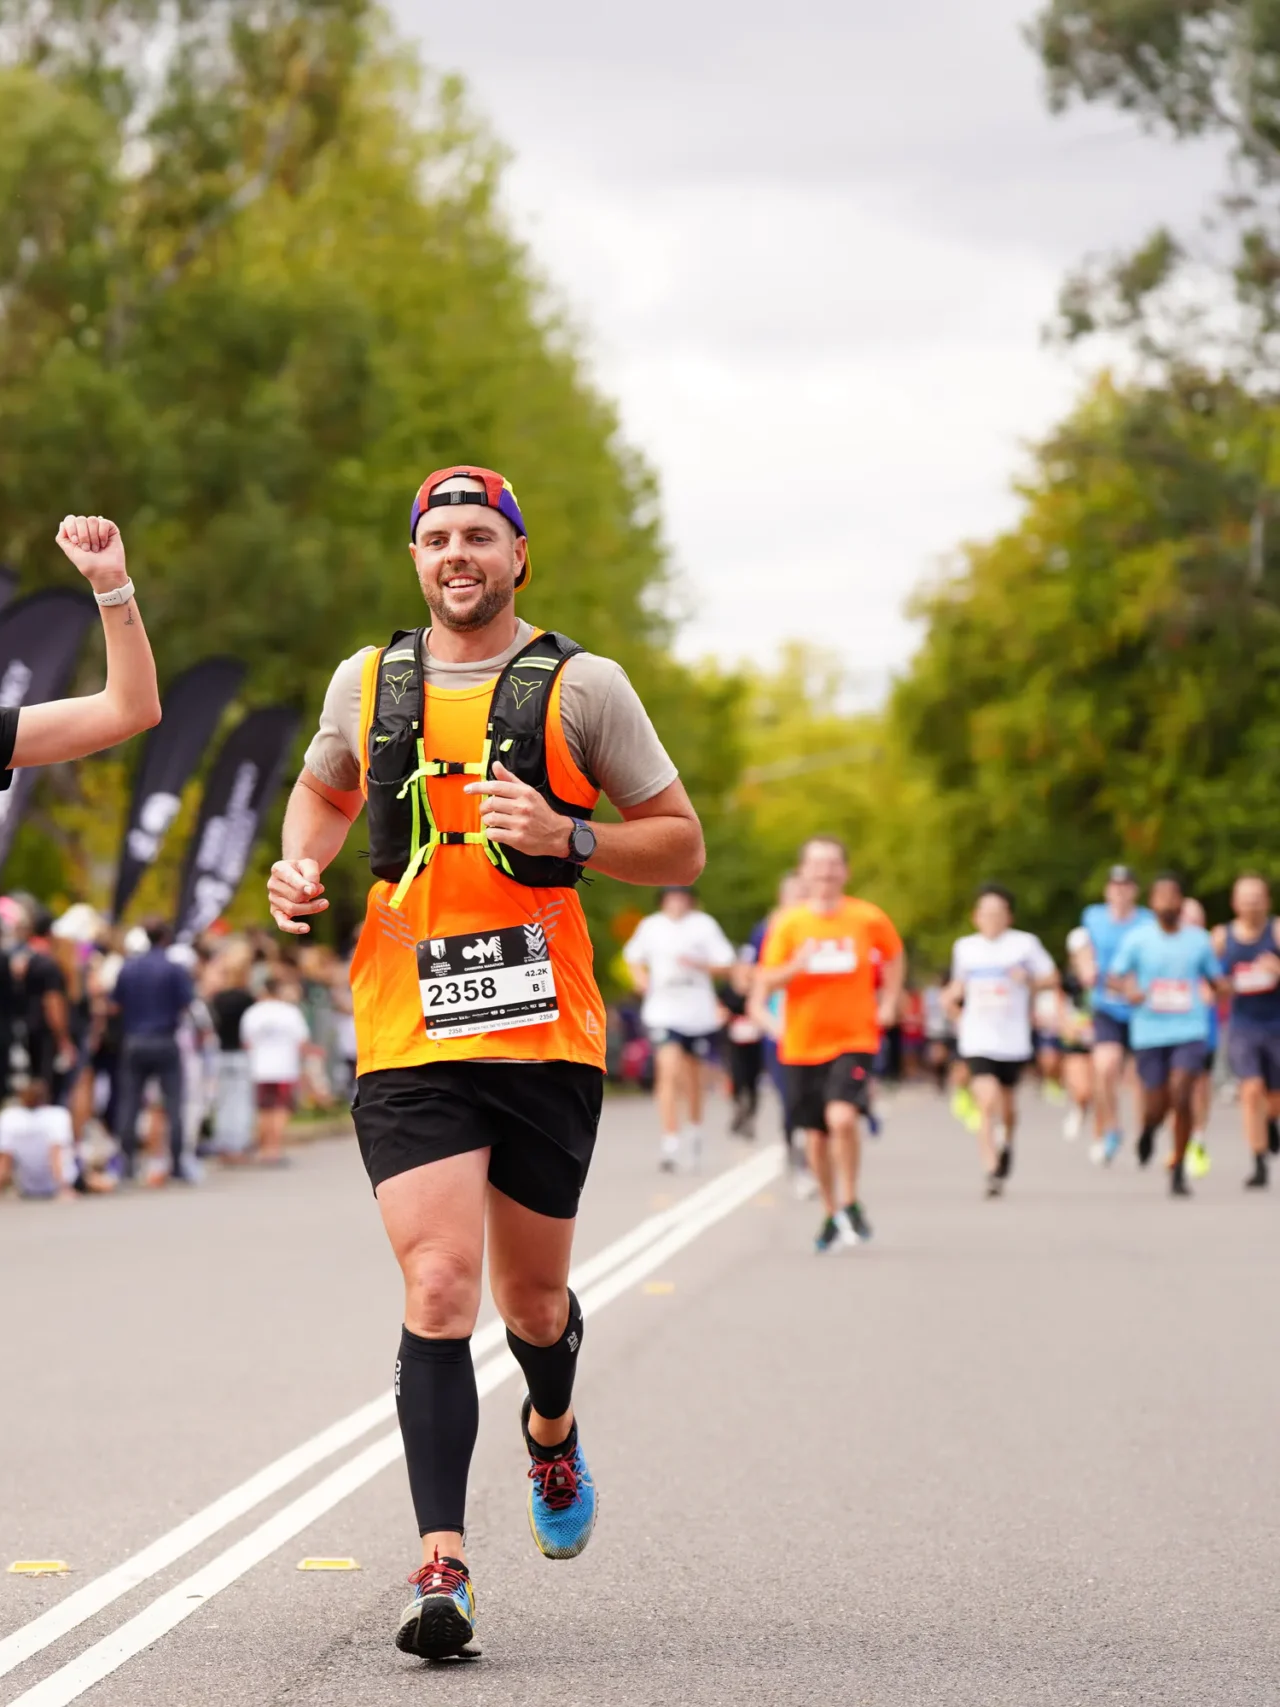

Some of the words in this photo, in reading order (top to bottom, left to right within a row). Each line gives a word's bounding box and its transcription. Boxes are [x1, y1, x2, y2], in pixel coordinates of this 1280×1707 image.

[525, 968, 548, 978] 42.2K
[427, 977, 497, 1007] 2358
[532, 983, 540, 992] B
[539, 1013, 554, 1021] 2358
[448, 1027, 463, 1035] 2358
